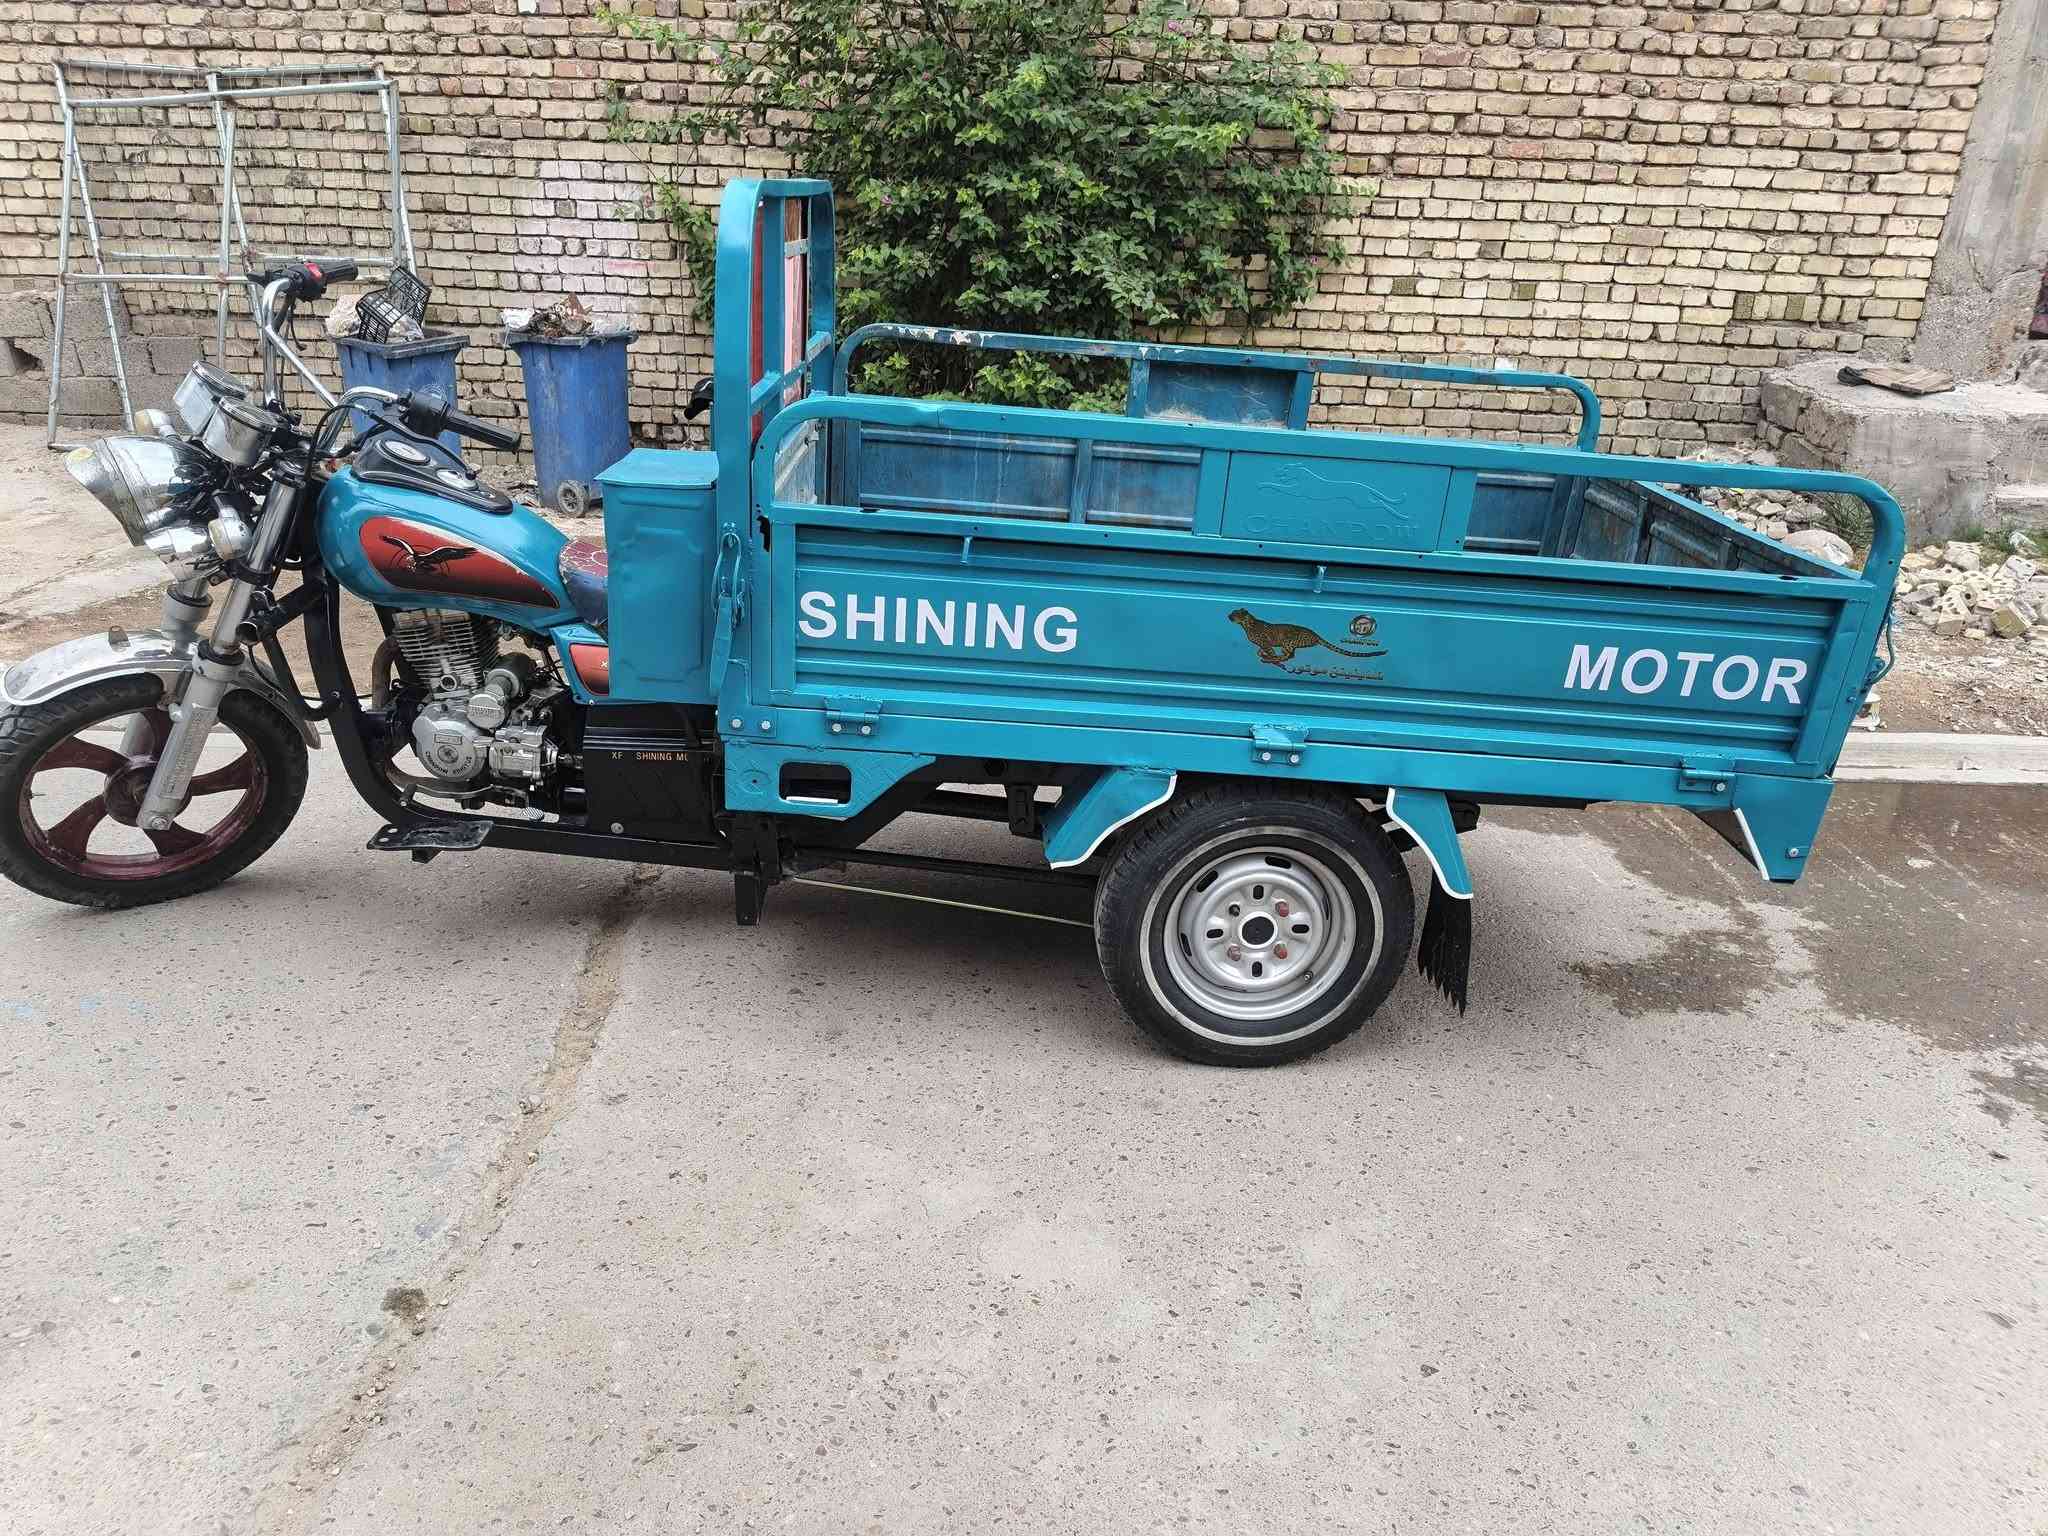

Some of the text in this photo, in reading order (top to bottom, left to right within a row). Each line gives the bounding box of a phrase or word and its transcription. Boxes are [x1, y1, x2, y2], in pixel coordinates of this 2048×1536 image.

[799, 591, 1808, 704] SHINING MOTOR
[636, 751, 672, 761] SHINING
